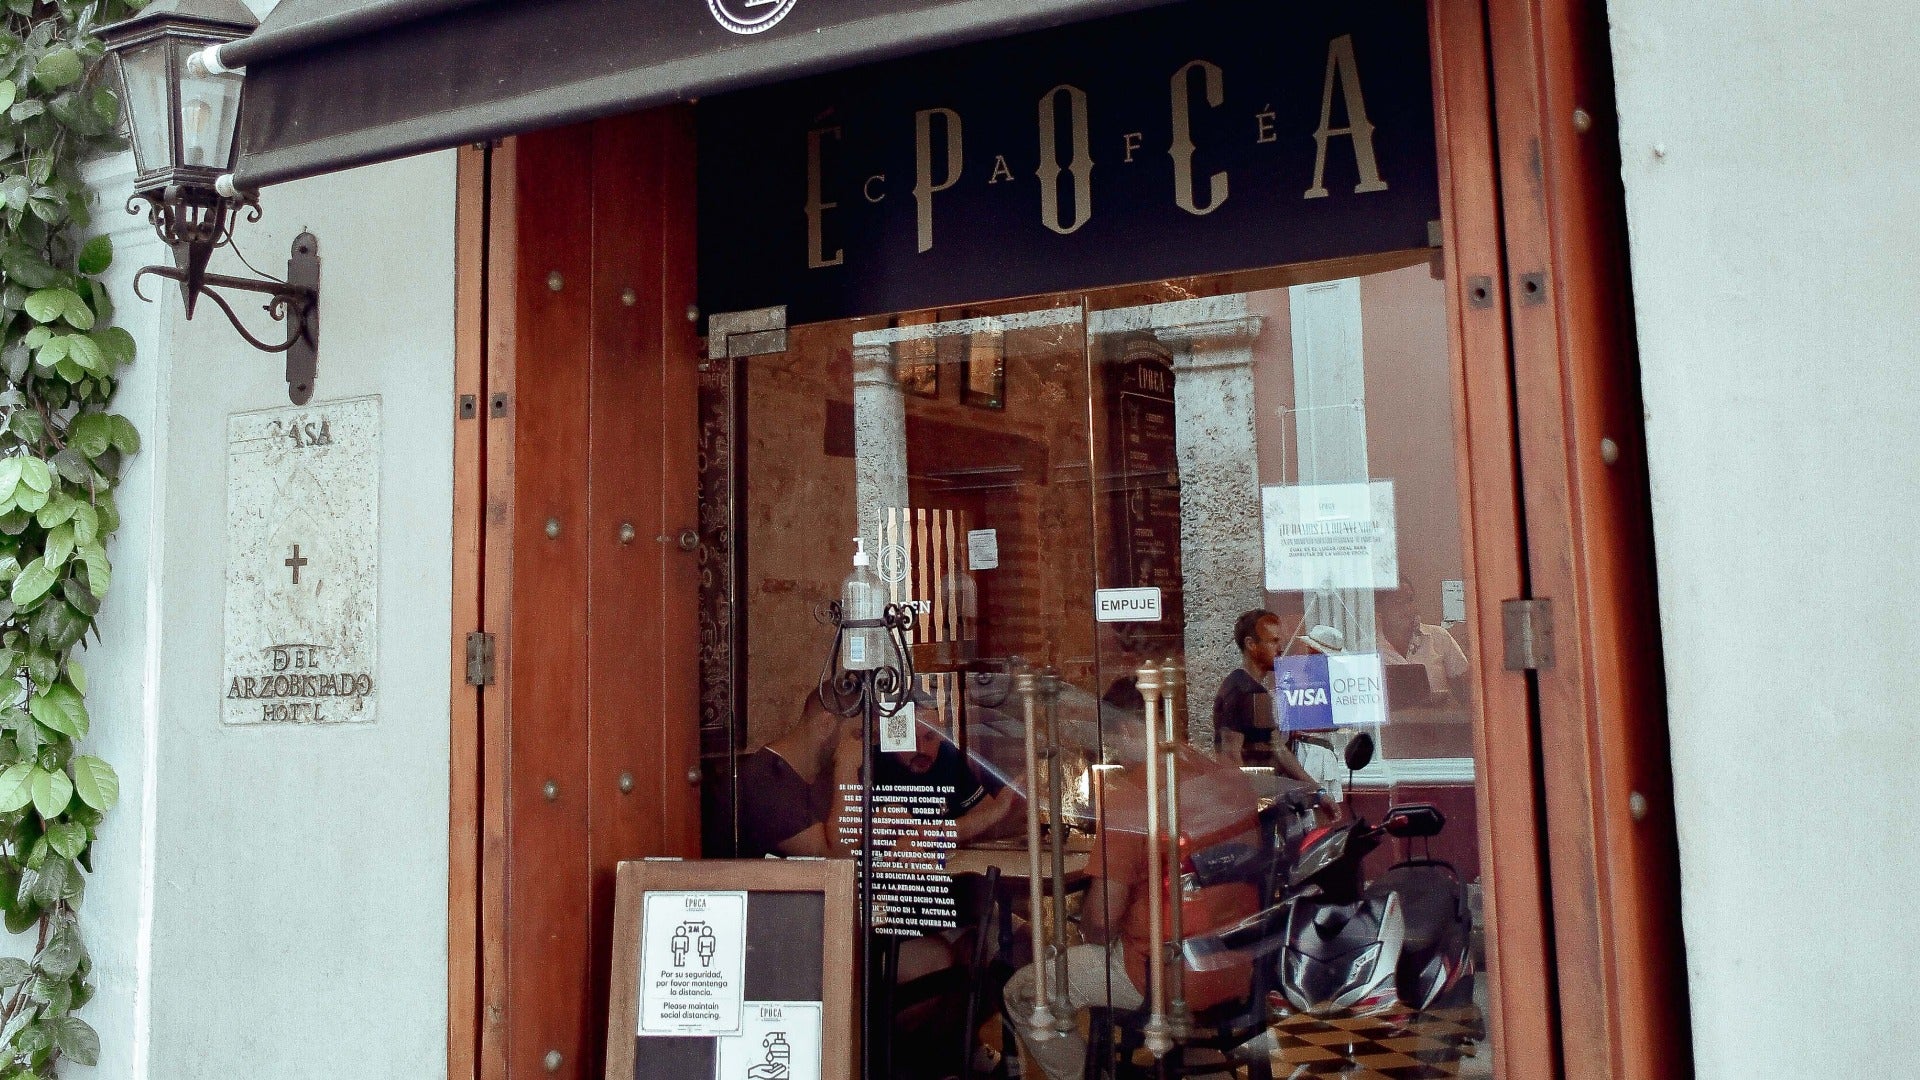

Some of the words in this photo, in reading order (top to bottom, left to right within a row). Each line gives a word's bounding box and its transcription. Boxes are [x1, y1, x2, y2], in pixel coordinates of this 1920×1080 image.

[804, 33, 1389, 269] ÉPOCA
[1101, 599, 1156, 611] EMPUJE
[272, 648, 319, 672] DEL
[227, 672, 373, 699] ARZOBISPADO
[1333, 676, 1380, 694] OPEN
[1284, 687, 1328, 707] VISA
[1335, 694, 1380, 706] ABIERTO
[914, 896, 933, 904] DICHO
[921, 908, 951, 916] FACTURA
[894, 929, 924, 937] PROPINA.
[685, 970, 723, 979] seguridad,
[691, 980, 728, 988] mantenga
[678, 988, 713, 996] distancia.
[663, 1002, 687, 1010] Please
[688, 1002, 719, 1010] maintain
[660, 1011, 681, 1019] social
